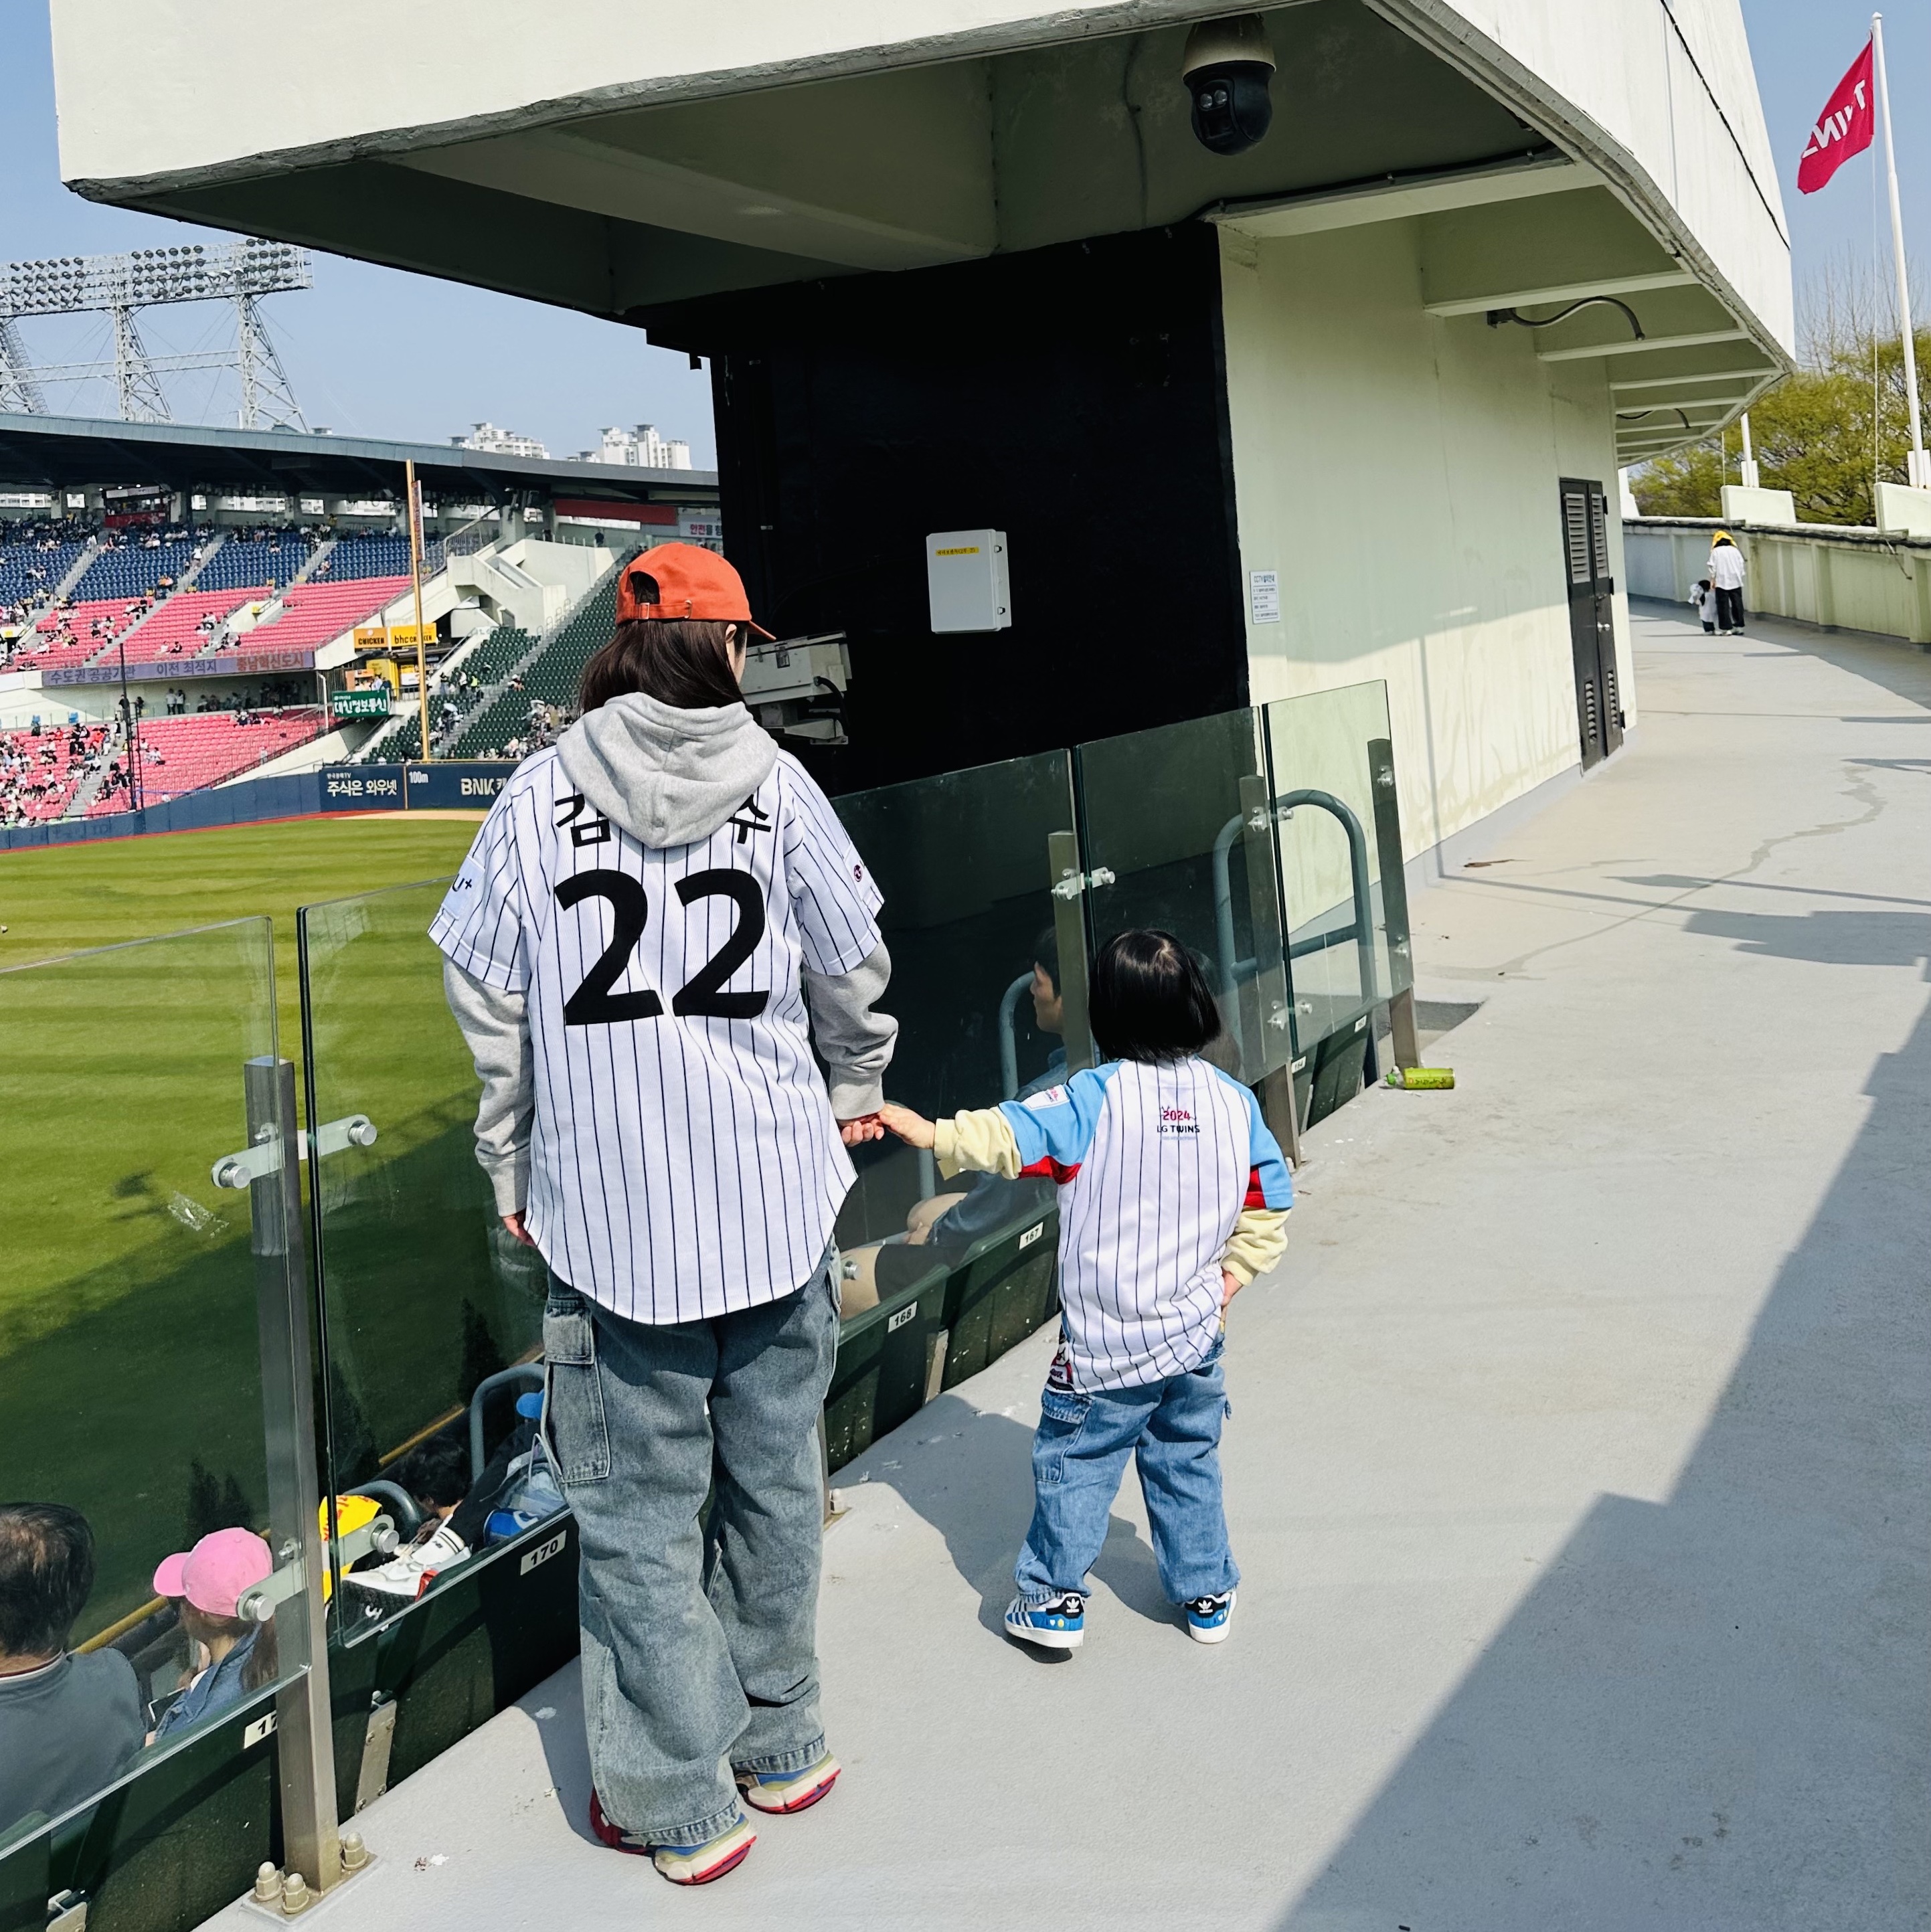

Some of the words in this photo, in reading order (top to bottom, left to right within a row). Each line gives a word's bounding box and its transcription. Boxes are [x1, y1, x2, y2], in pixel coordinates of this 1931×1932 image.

[358, 637, 385, 645] CHICKEN
[394, 635, 408, 644] bhc
[51, 669, 86, 684] 수도권
[157, 662, 179, 677] 이전
[183, 659, 217, 674] 최적지
[409, 771, 429, 784] 100m
[327, 780, 363, 797] 주식은
[365, 779, 397, 796] 와우넷
[460, 778, 496, 796] BNK
[553, 867, 770, 1027] 22
[1163, 1110, 1190, 1121] 2024
[1157, 1125, 1168, 1133] LG
[1170, 1125, 1200, 1133] TWINS
[1025, 1227, 1039, 1244] 167
[894, 1308, 912, 1326] 168
[531, 1539, 558, 1565] 170
